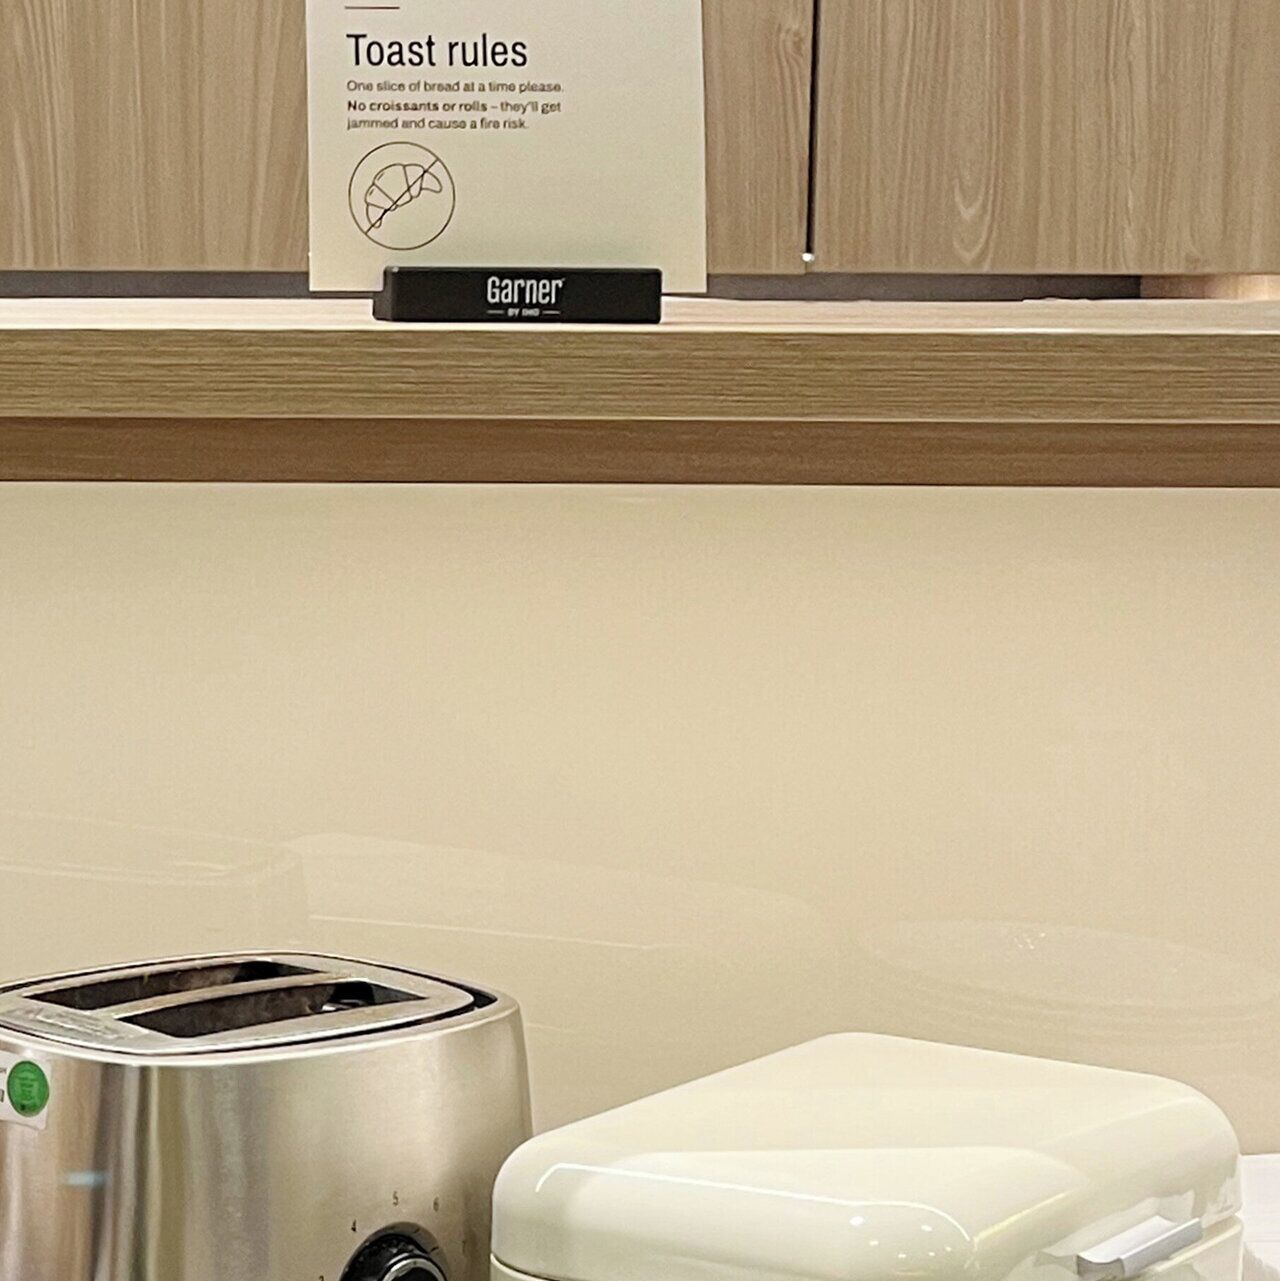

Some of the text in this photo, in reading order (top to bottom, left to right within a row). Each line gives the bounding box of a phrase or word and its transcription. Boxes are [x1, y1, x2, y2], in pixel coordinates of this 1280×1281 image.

[346, 33, 528, 67] Toast rules
[347, 80, 564, 94] One slice of bread at a time please.
[347, 100, 366, 111] No
[369, 100, 439, 111] croissants
[442, 102, 456, 112] or
[459, 101, 488, 112] rolls
[541, 102, 562, 114] get
[347, 117, 399, 130] jammed
[401, 117, 426, 129] and
[428, 120, 467, 129] cause
[470, 120, 477, 129] a
[480, 117, 500, 129] fire
[487, 276, 563, 304] Garner
[350, 1219, 358, 1233] 4
